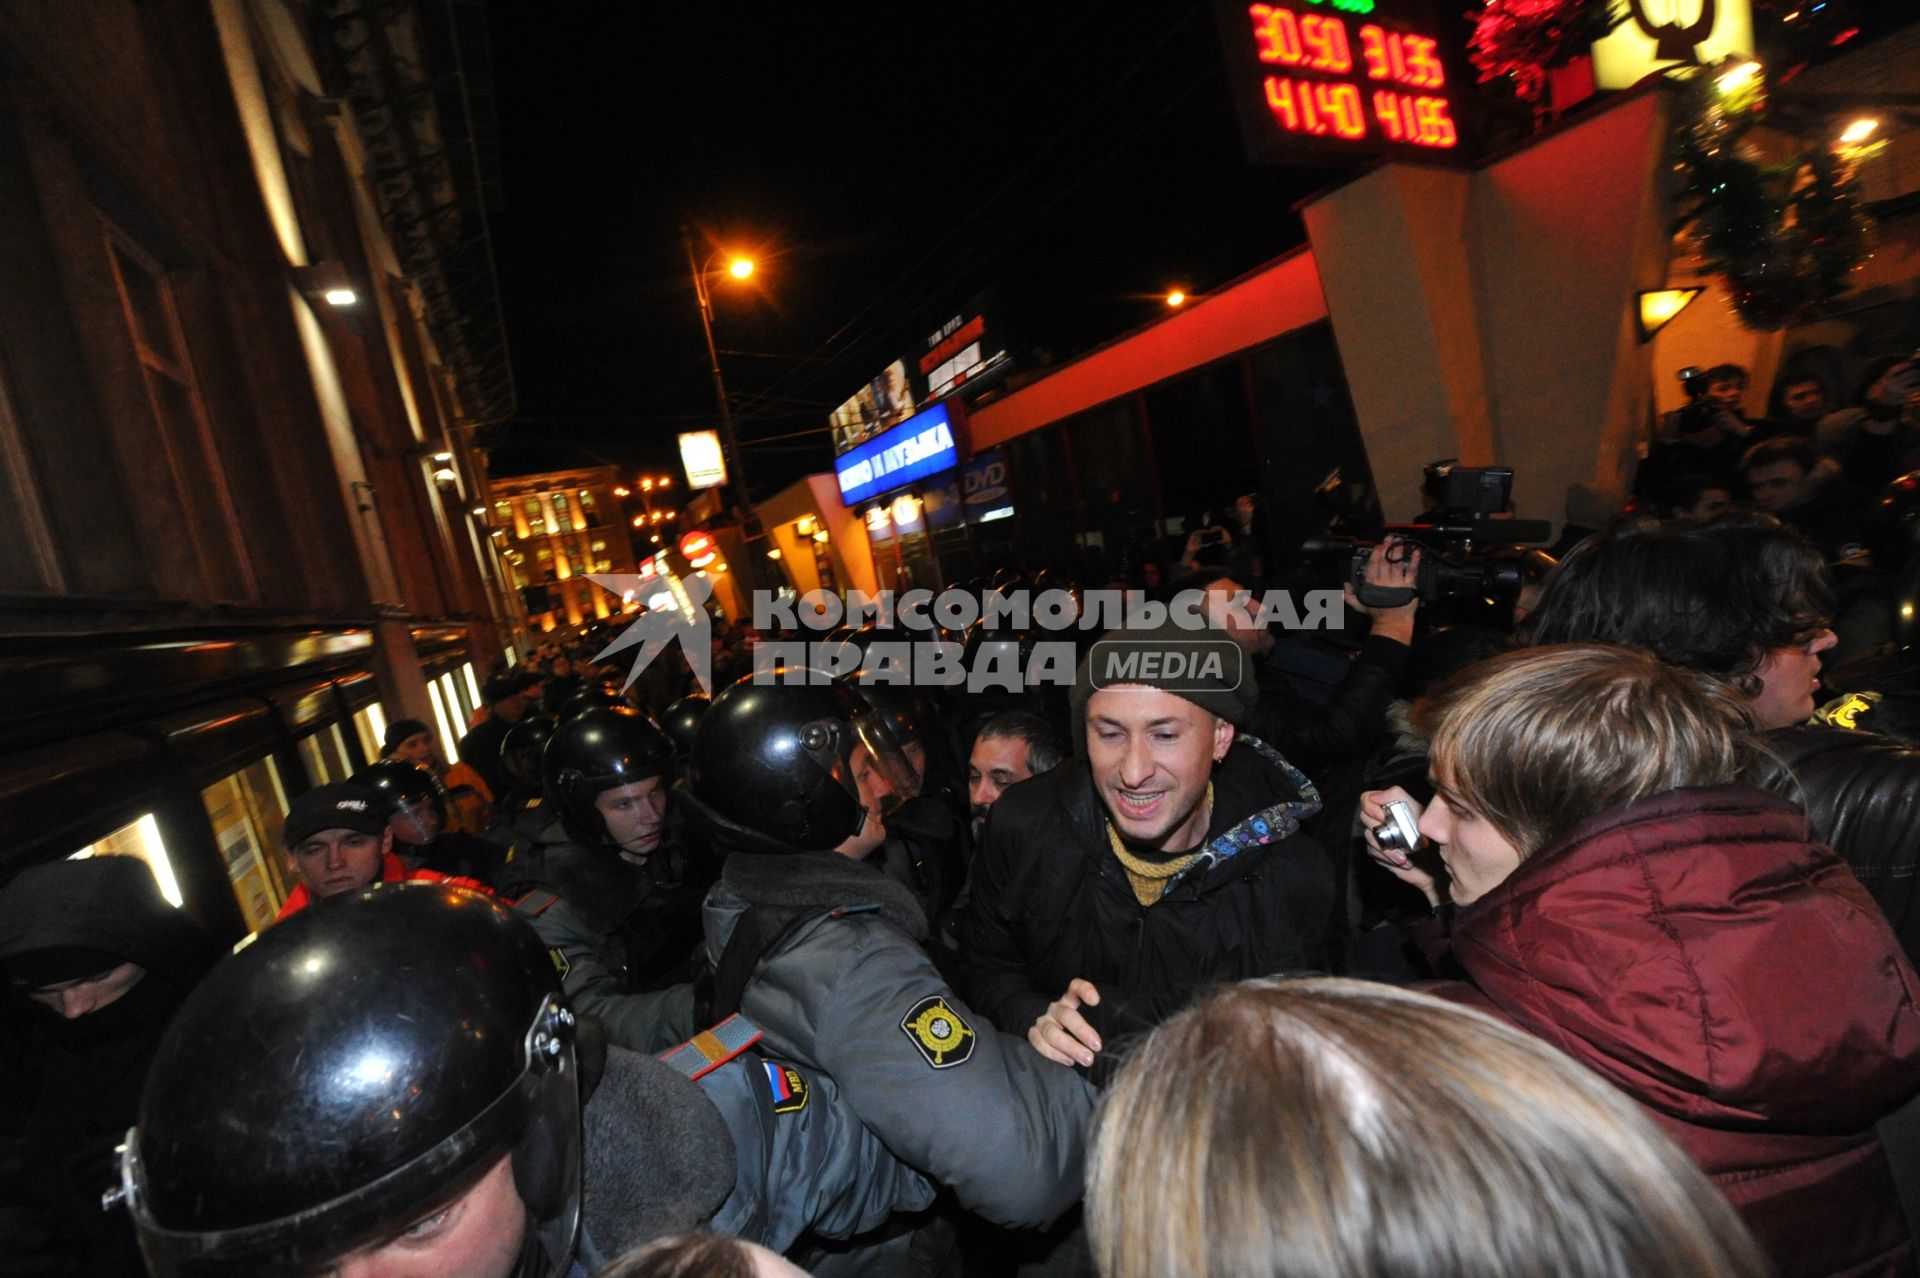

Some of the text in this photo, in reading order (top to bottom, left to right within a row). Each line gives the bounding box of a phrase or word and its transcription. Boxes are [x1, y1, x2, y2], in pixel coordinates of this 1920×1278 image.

[1250, 4, 1444, 88] 30.50 31.35
[1265, 77, 1365, 138] 41.40
[964, 462, 1006, 494] DVD
